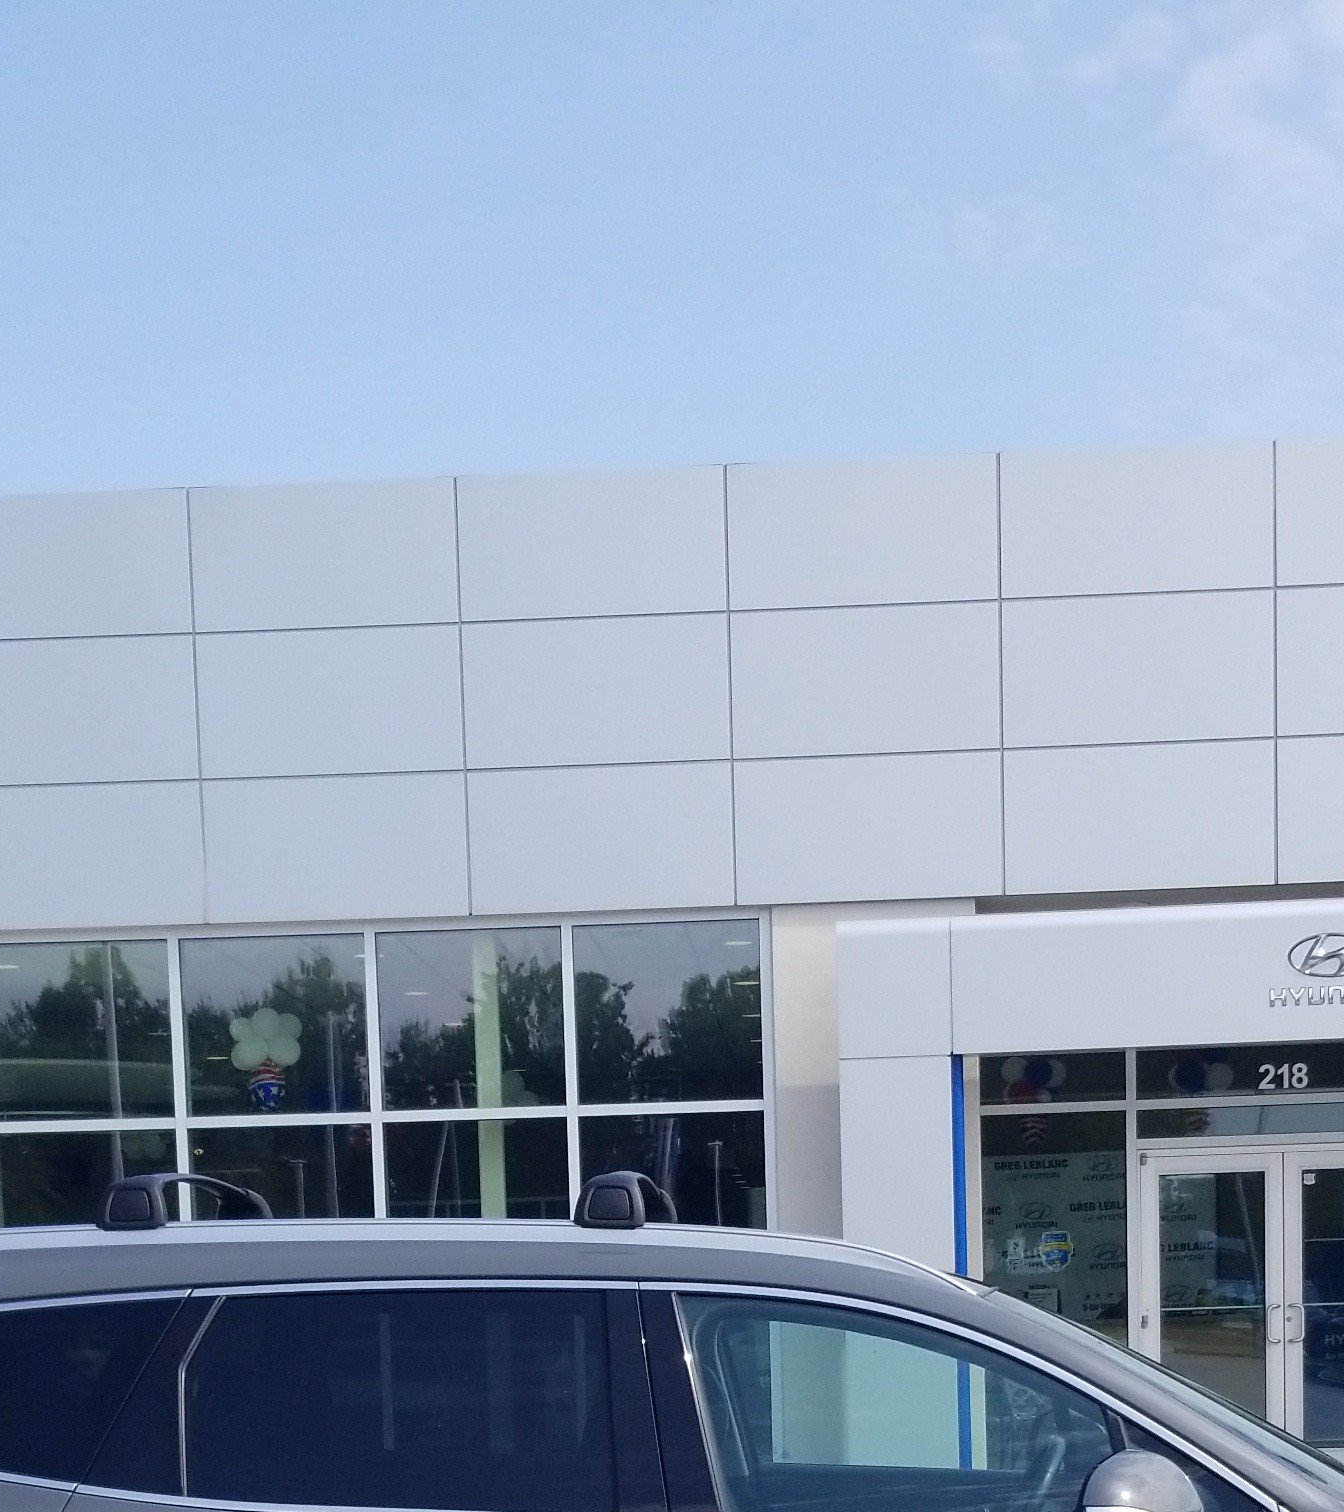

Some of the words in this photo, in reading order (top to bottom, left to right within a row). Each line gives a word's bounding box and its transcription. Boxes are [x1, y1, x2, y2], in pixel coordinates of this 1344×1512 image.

[1258, 1063, 1308, 1090] 218
[994, 1161, 1021, 1170] GREG
[1023, 1159, 1069, 1170] LEBLANC
[1069, 1202, 1096, 1213] GREG
[1098, 1200, 1127, 1211] LEBL
